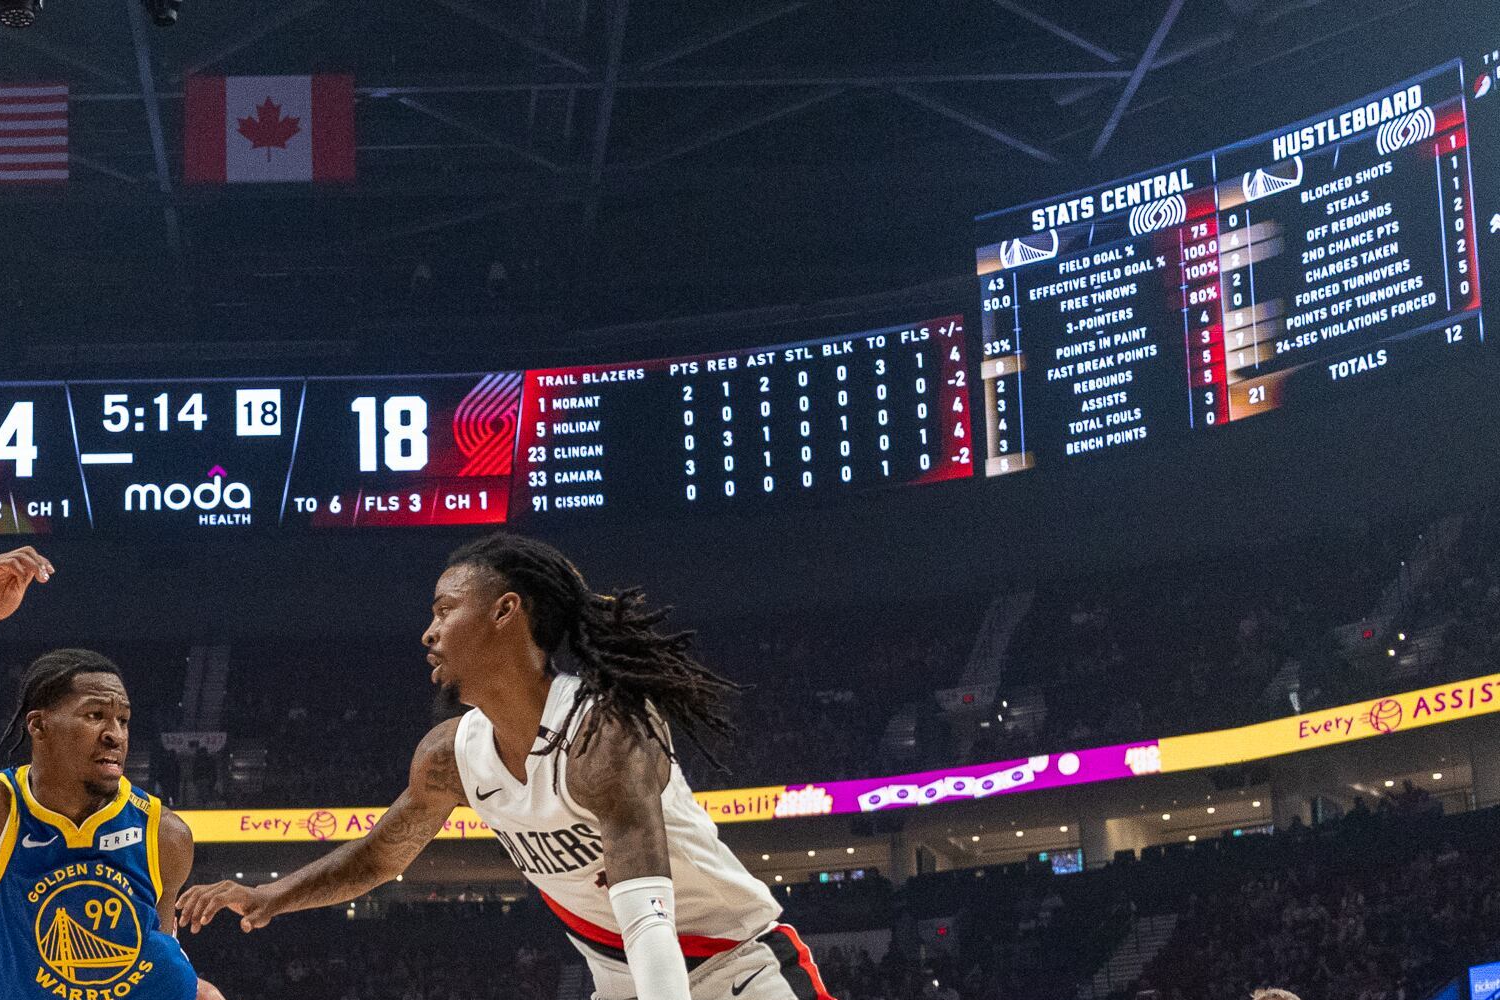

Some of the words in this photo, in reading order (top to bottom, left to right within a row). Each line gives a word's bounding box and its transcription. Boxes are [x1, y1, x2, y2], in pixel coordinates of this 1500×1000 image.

[1272, 84, 1422, 161] HUSTLEBOARD
[1301, 175, 1352, 204] BLOCKED
[1355, 161, 1393, 186] SHOTS
[1032, 196, 1094, 231] STATS
[1101, 168, 1194, 213] CENTRAL
[1326, 190, 1370, 216] STEALS
[1306, 226, 1328, 242] OFF
[1331, 202, 1392, 235] REBOUNDS
[1301, 246, 1325, 265] 2ND
[1328, 229, 1373, 256] CHANCE
[1377, 221, 1400, 238] PTS
[1059, 256, 1090, 275] FIELD
[1094, 249, 1122, 266] GOAL
[1305, 256, 1358, 284] CHARGES
[1361, 242, 1399, 265] TAKEN
[1029, 274, 1087, 300] EFFECTIVE
[1090, 268, 1121, 286] FIELD
[1124, 260, 1153, 276] GOAL
[1295, 283, 1340, 308] FORCED
[1342, 259, 1411, 292] TURNOVERS
[1060, 296, 1089, 312] FREE
[1091, 283, 1137, 304] THROWS
[1286, 306, 1327, 331] POINTS
[1331, 298, 1353, 316] OFF
[1356, 275, 1424, 306] TURNOVERS
[1066, 307, 1134, 334] 3-POINTERS
[1276, 330, 1318, 354] 24-SEC
[1321, 307, 1388, 338] VIOLATIONS
[1391, 292, 1436, 319] FORCED
[670, 362, 698, 377] PTS
[707, 357, 737, 372] REB
[747, 353, 776, 368] AST
[785, 348, 813, 362] STL
[822, 342, 853, 357] BLK
[867, 336, 886, 349] TO
[901, 328, 929, 343] FLS
[1056, 340, 1096, 360] POINTS
[1099, 336, 1111, 349] IN
[1114, 327, 1147, 346] PAINT
[537, 375, 577, 387] TRAIL
[583, 368, 645, 384] BLAZERS
[1048, 366, 1074, 381] FAST
[1077, 357, 1114, 375] BREAK
[1117, 344, 1158, 364] POINTS
[1328, 349, 1388, 381] TOTALS
[1074, 370, 1133, 395] REBOUNDS
[538, 398, 545, 413] 1
[552, 396, 600, 410] MORANT
[1081, 391, 1127, 413] ASSISTS
[102, 394, 207, 432] 5:14
[243, 401, 278, 427] 18
[351, 396, 428, 472] 18
[536, 422, 546, 437] 5
[553, 421, 600, 435] HOLIDAY
[1069, 420, 1103, 435] TOTAL
[1106, 407, 1142, 426] FOULS
[528, 447, 546, 462] 23
[554, 445, 603, 460] CLINGAN
[1066, 438, 1103, 456] BENCH
[1107, 426, 1147, 445] POINTS
[124, 474, 251, 511] moda
[528, 471, 547, 487] 33
[554, 470, 602, 484] CAMARA
[27, 502, 52, 517] CH
[61, 500, 69, 518] 1
[294, 498, 317, 513] TO
[330, 495, 341, 513] 6
[365, 495, 399, 511] FLS
[408, 493, 421, 512] 3
[444, 494, 470, 509] CH
[479, 492, 488, 509] 1
[532, 496, 547, 511] 91
[555, 494, 604, 508] CISSOKO
[198, 514, 251, 525] HEALTH
[1299, 717, 1353, 738] Every
[1413, 682, 1500, 719] ASSIS
[103, 830, 139, 848] IREN
[240, 816, 291, 837] Every
[444, 820, 489, 838] equa
[28, 863, 88, 903] GOLDEN
[84, 897, 122, 930] 99
